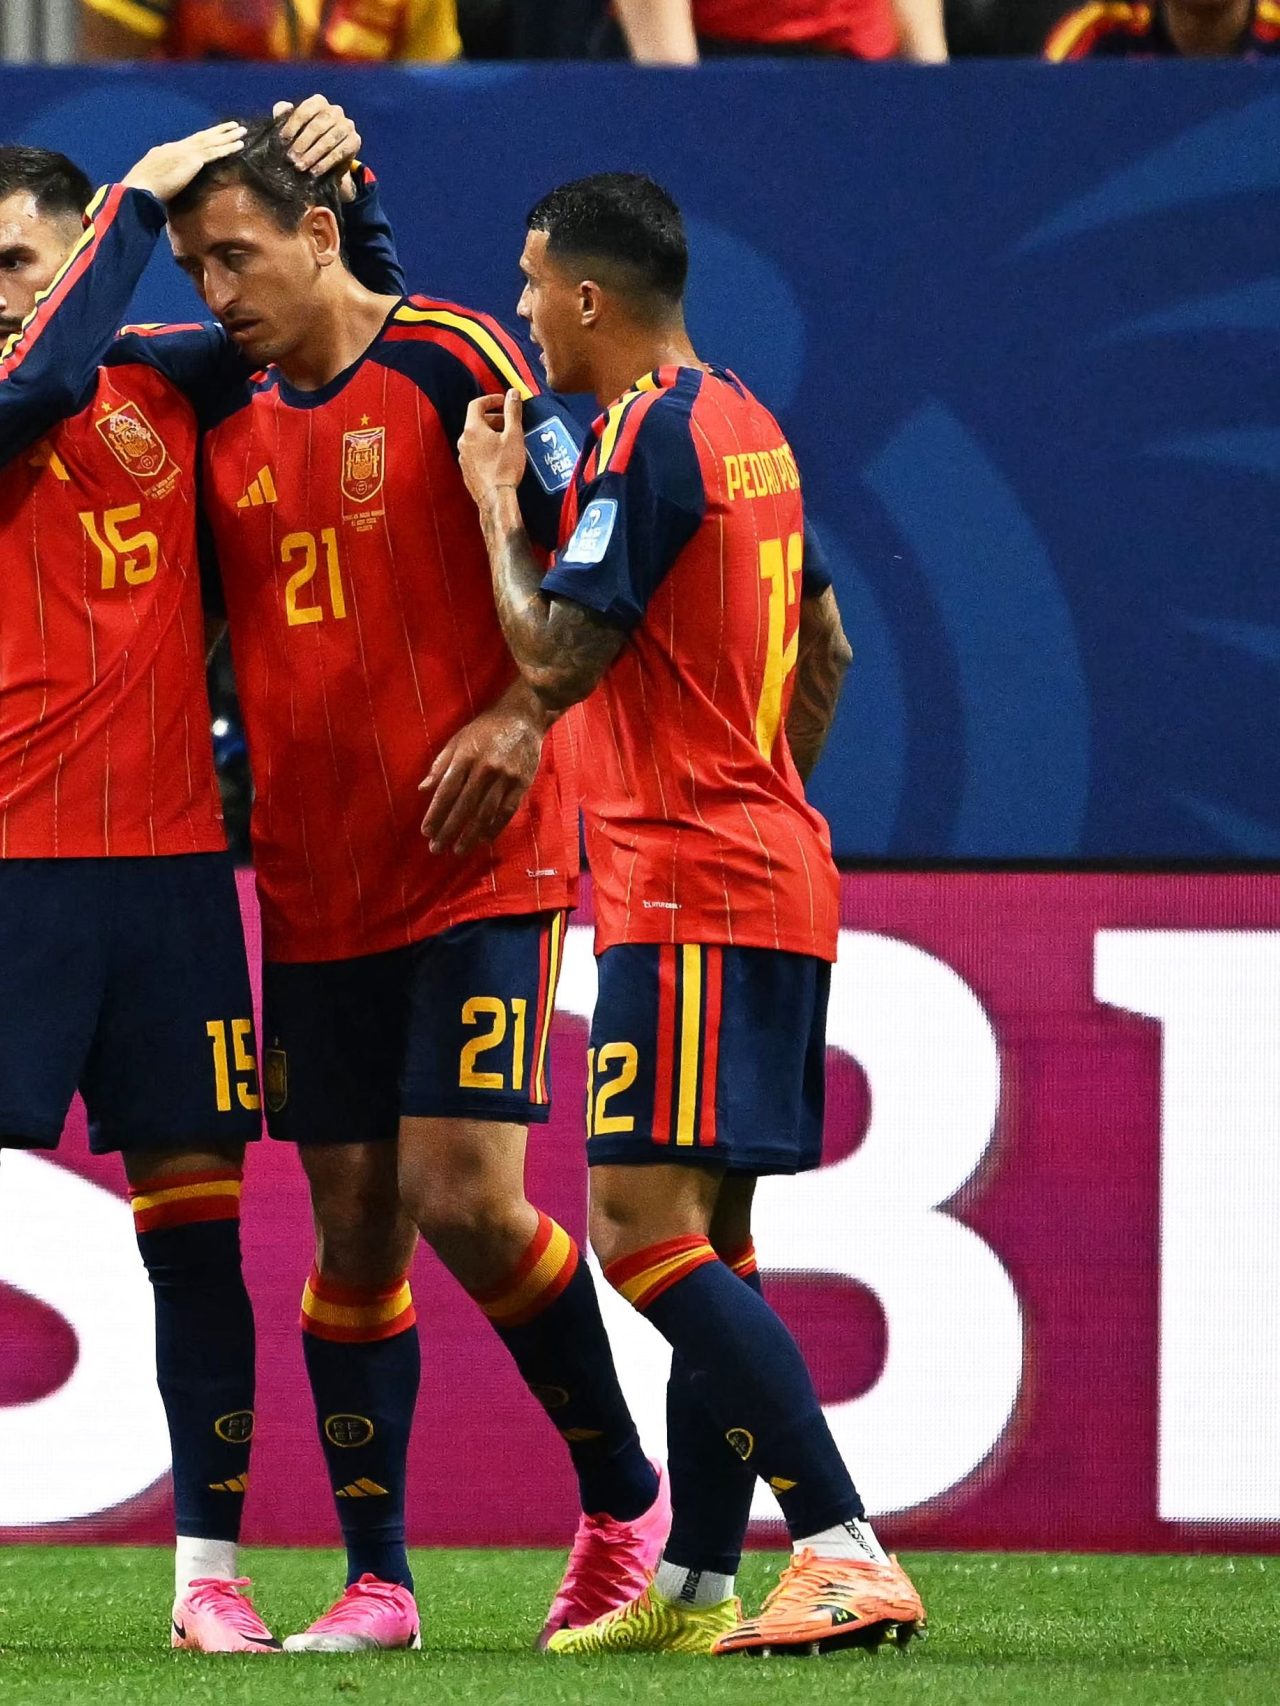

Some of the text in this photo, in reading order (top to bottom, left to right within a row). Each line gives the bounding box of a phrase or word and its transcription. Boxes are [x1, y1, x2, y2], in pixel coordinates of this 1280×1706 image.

[78, 503, 158, 590] 15
[281, 527, 347, 626] 21
[206, 1019, 261, 1111] 15
[459, 996, 527, 1090] 21
